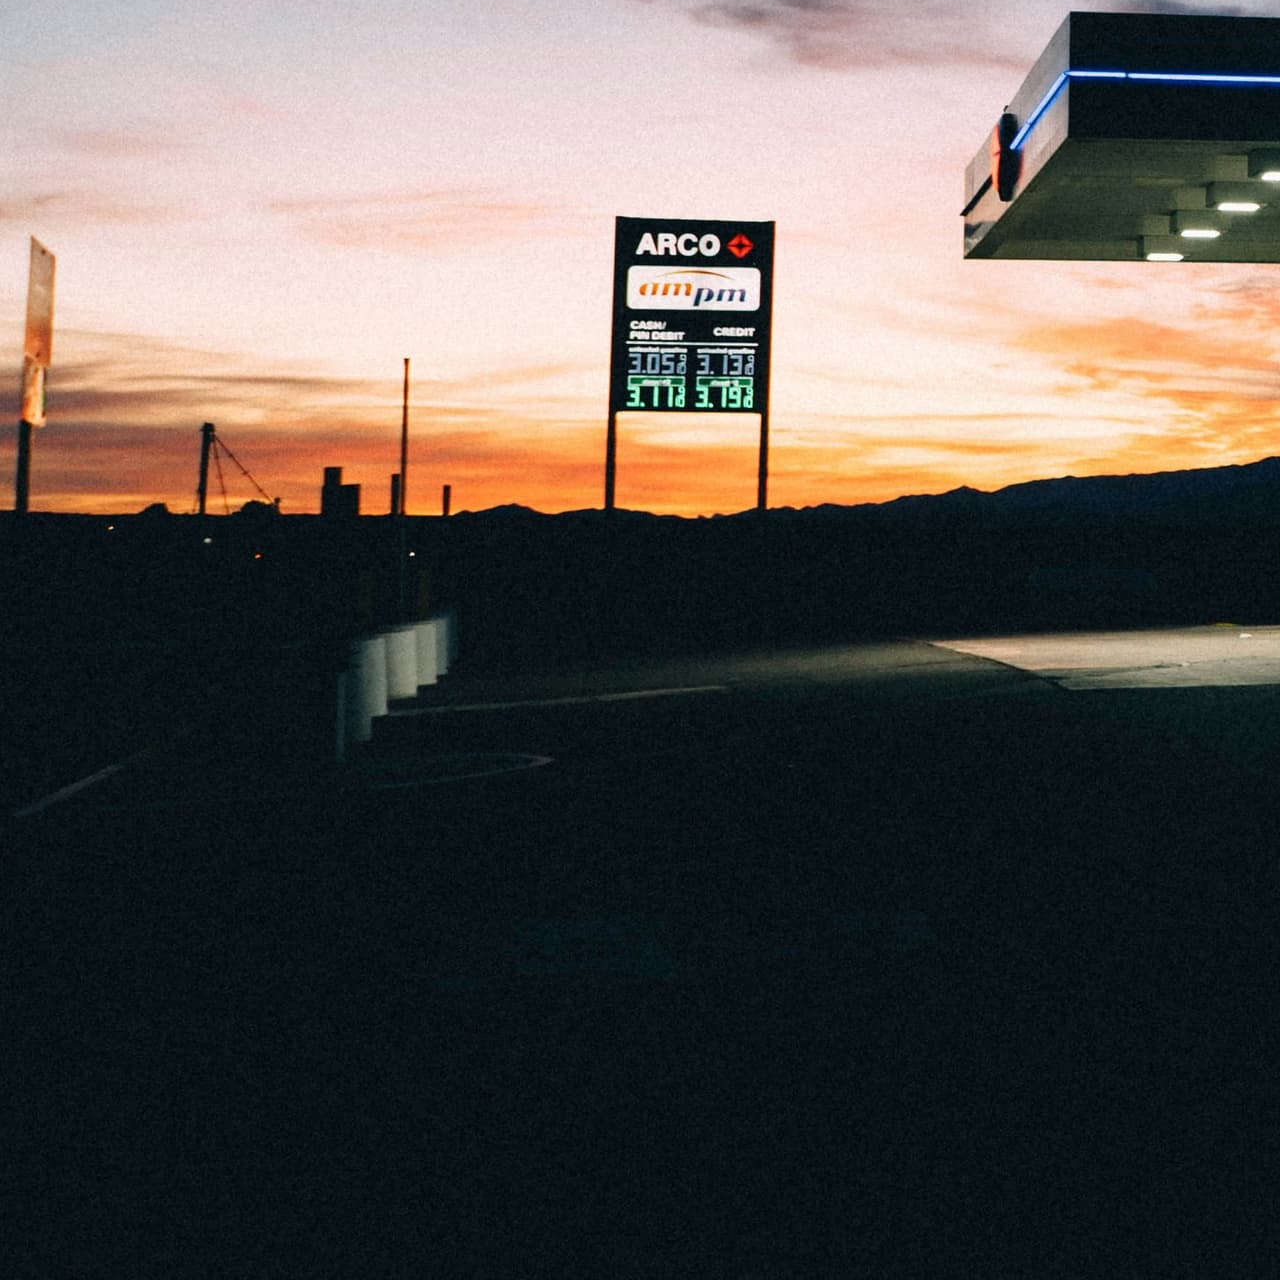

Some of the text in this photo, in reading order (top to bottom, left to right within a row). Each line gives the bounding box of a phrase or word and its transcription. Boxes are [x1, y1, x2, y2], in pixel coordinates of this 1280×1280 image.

[635, 232, 721, 257] ARCO
[639, 282, 747, 307] ampm
[713, 327, 756, 337] CREDIT
